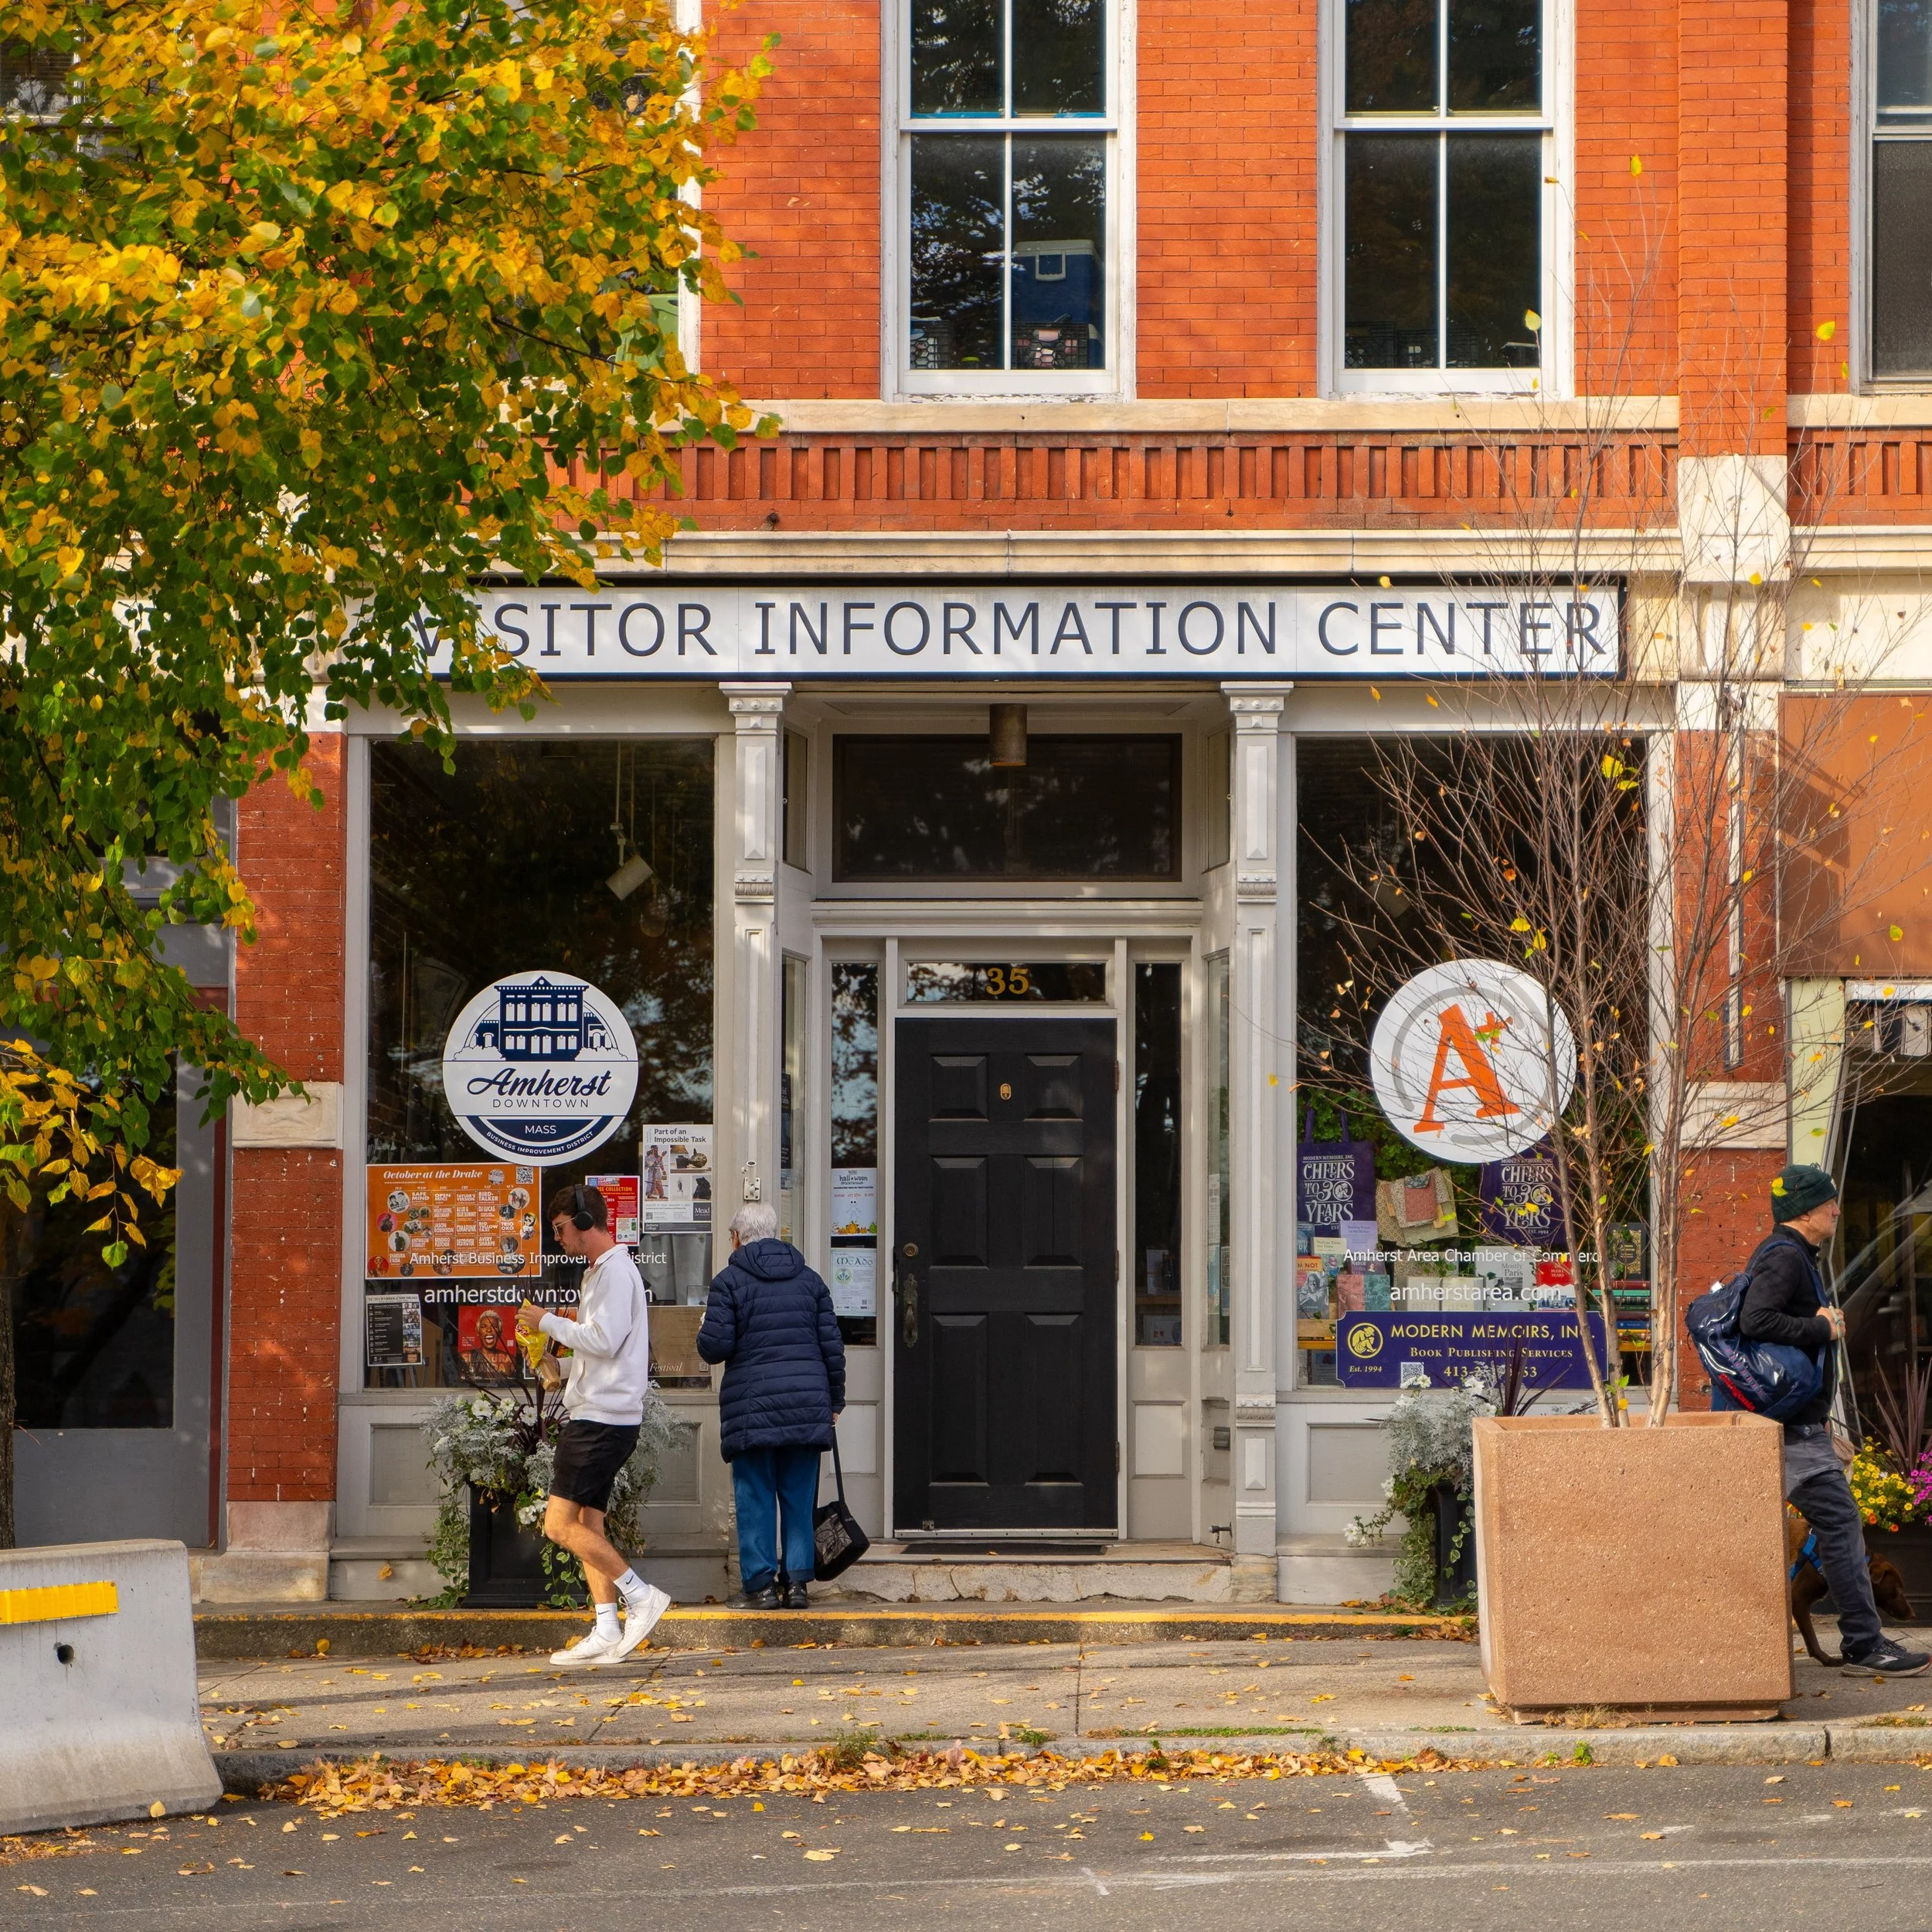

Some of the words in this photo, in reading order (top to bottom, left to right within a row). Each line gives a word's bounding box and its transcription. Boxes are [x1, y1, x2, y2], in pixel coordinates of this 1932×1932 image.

[410, 603, 718, 657] VSITOR
[754, 601, 1277, 656] INFORMATION
[1318, 601, 1607, 656] CENTER
[986, 968, 1029, 995] 35
[467, 1067, 612, 1096] Amherst
[492, 1099, 589, 1108] DOWNTOWN
[525, 1125, 556, 1134] MASS
[486, 1131, 516, 1150] BUSINESS
[517, 1145, 565, 1155] IMPROVEMENT
[566, 1131, 594, 1150] DISTRICT
[383, 1170, 422, 1179] October
[452, 1169, 483, 1178] Drake
[1303, 1162, 1355, 1181] CHEERS
[1502, 1165, 1553, 1184] CHEERS
[1304, 1182, 1319, 1195] TO
[1502, 1185, 1517, 1198] TO
[1305, 1199, 1353, 1225] YEARS
[410, 1252, 464, 1264] Amherst
[469, 1252, 525, 1264] Business
[628, 1252, 667, 1264] istrict
[1343, 1249, 1403, 1262] Amherst
[1406, 1249, 1439, 1262] Area
[1444, 1249, 1509, 1262] Chamber
[1513, 1249, 1526, 1262] of
[1390, 1283, 1561, 1301] amherstarea.com
[1391, 1325, 1463, 1338] MODERN
[1471, 1325, 1554, 1340] MEMOIRS,
[1561, 1325, 1595, 1338] IN.
[1410, 1347, 1442, 1357] BOOK
[1521, 1347, 1573, 1358] SERVICES
[649, 1362, 682, 1372] Festival
